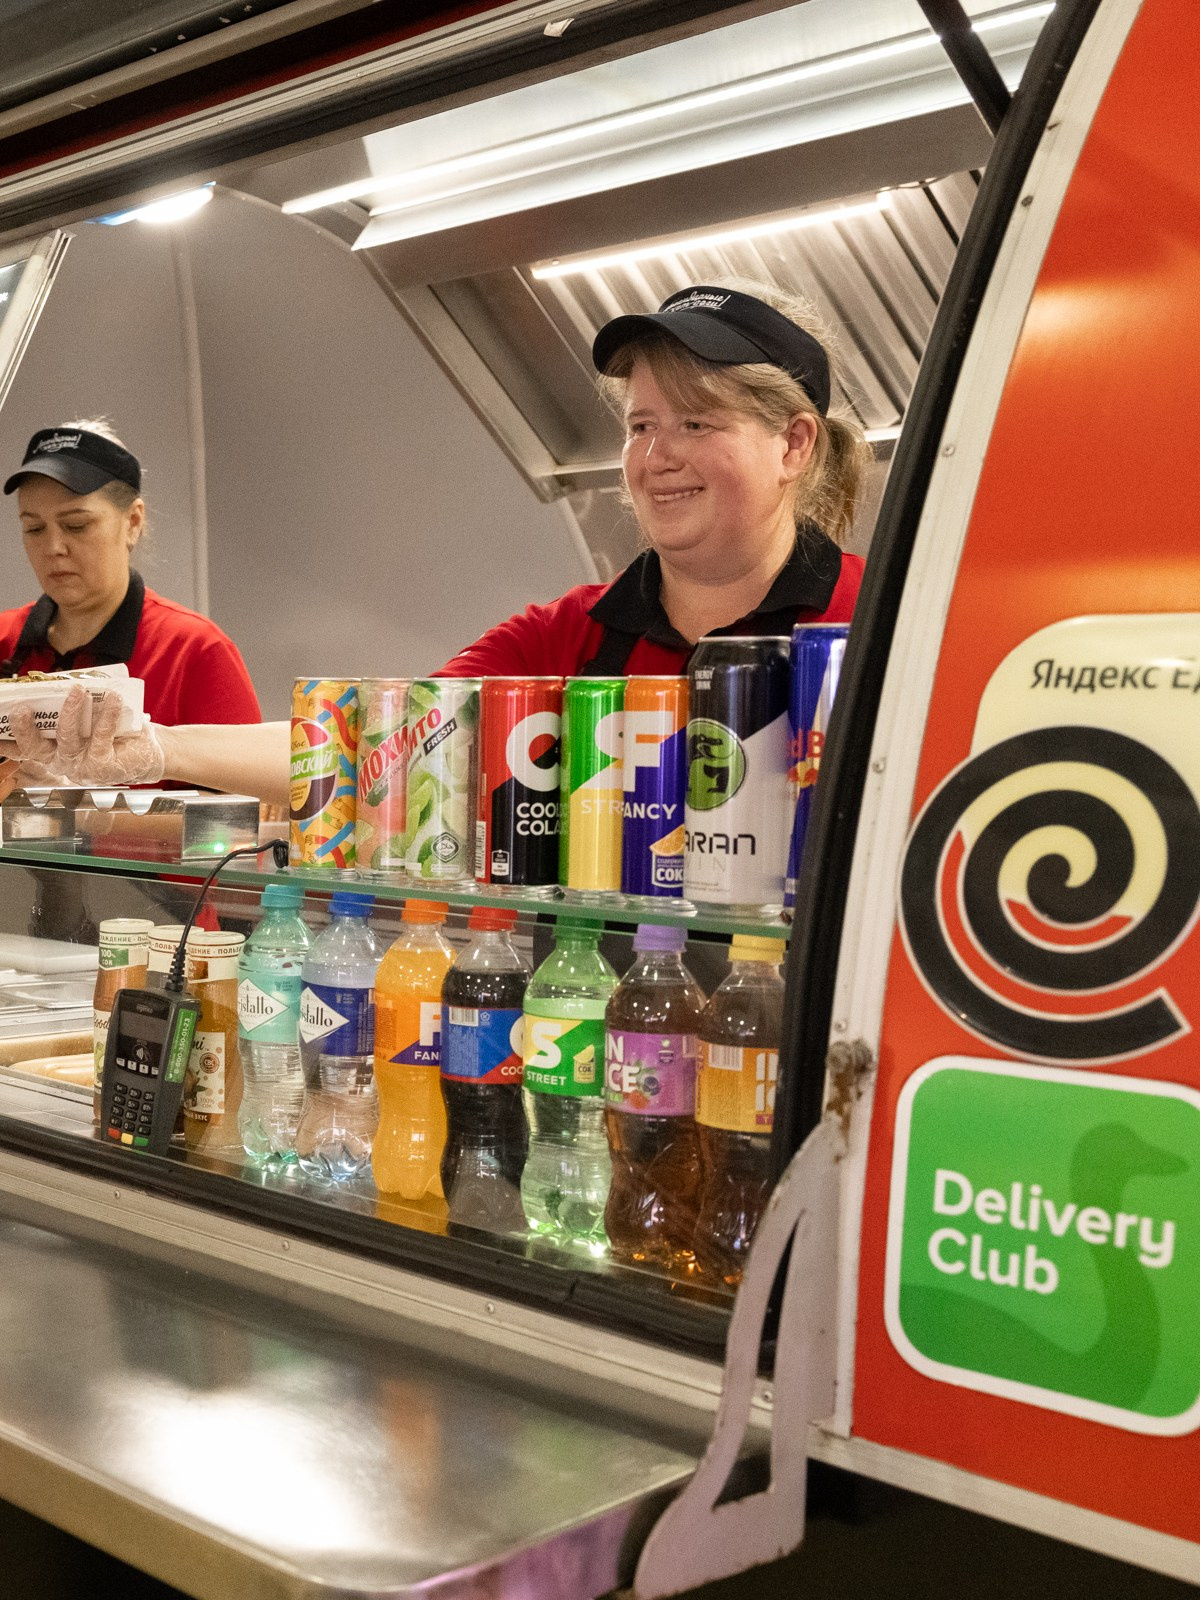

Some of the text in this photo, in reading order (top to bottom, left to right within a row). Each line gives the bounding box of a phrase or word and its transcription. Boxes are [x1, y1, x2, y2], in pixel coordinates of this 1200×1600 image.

[1031, 658, 1162, 694] Яндекс
[425, 721, 456, 751] FRESH
[622, 711, 674, 792] F
[622, 803, 678, 820] ANCY
[414, 1050, 441, 1061] FAN
[527, 1072, 566, 1086] STREET
[932, 1168, 1175, 1269] Delivery
[928, 1227, 1060, 1294] Club
